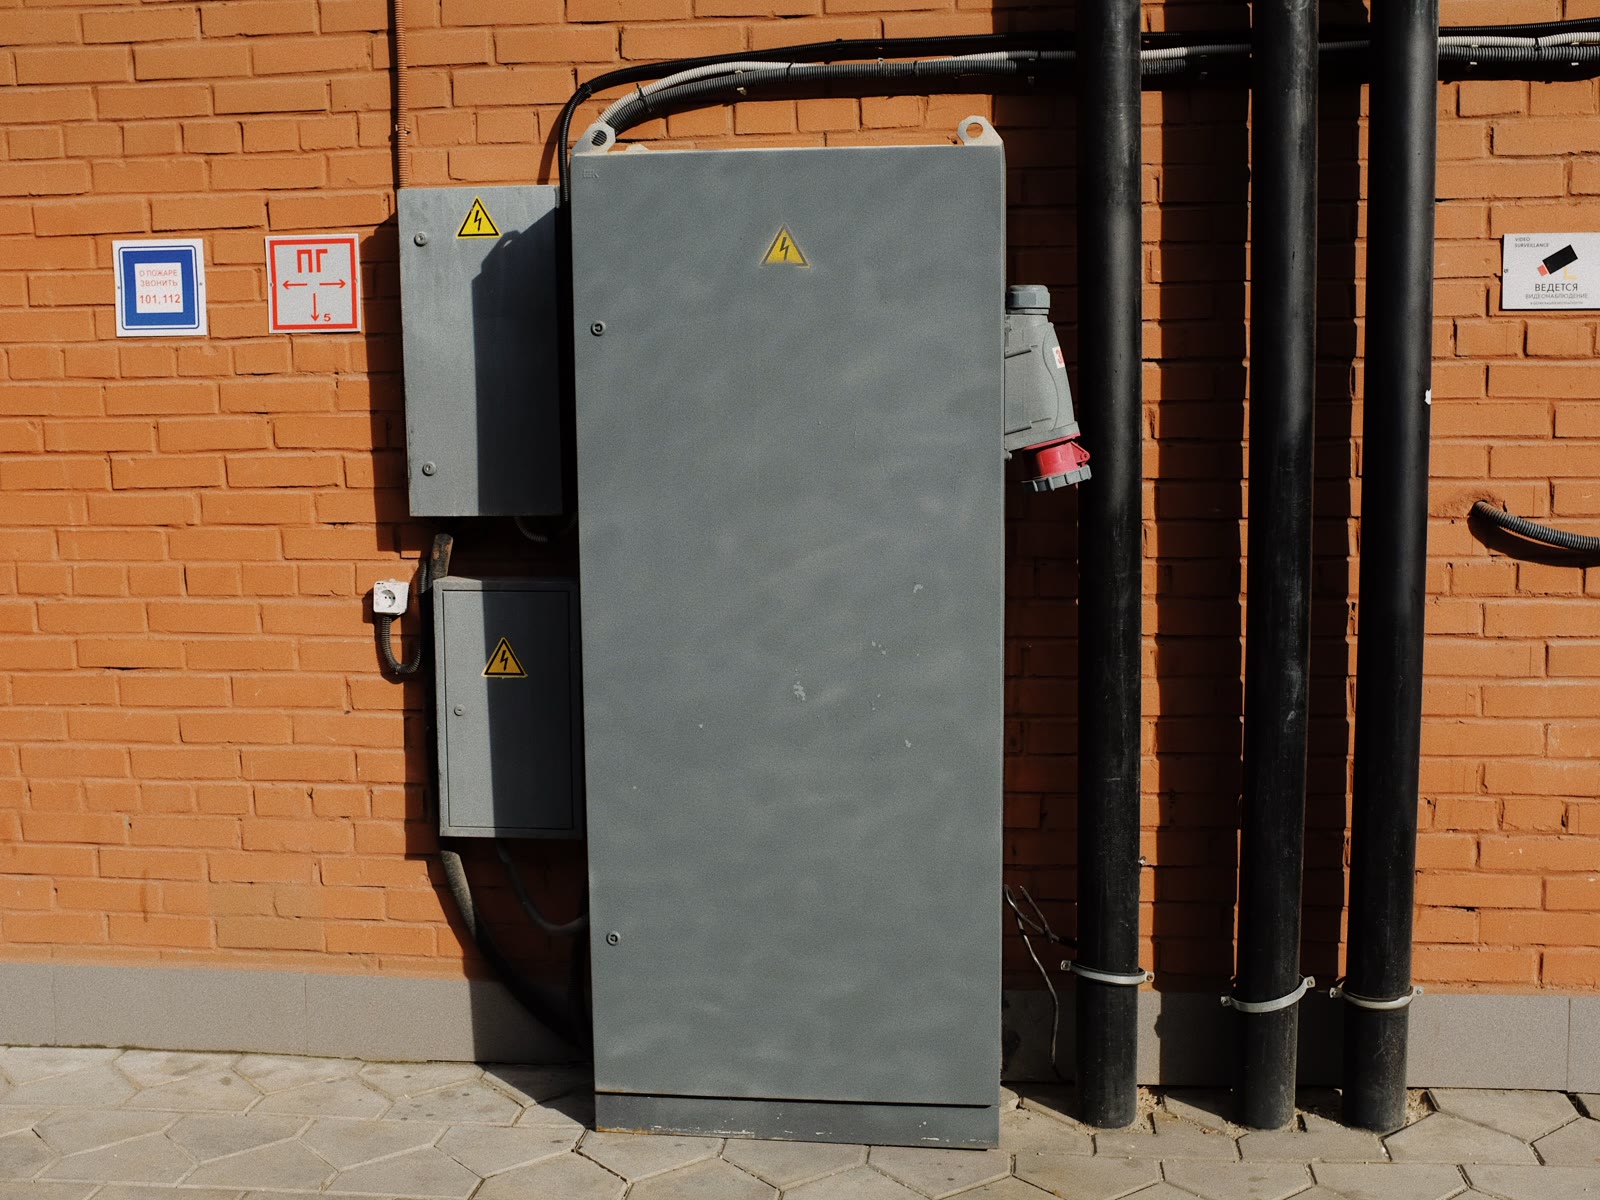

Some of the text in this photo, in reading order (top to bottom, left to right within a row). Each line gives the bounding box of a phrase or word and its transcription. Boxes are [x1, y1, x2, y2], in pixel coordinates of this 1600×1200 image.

[297, 248, 328, 273] ПГ
[146, 269, 178, 277] ПОЖАРЕ
[140, 279, 178, 287] ЗВОНИТЬ
[1534, 283, 1578, 293] ВЕДЕТСЯ
[323, 313, 331, 322] 5
